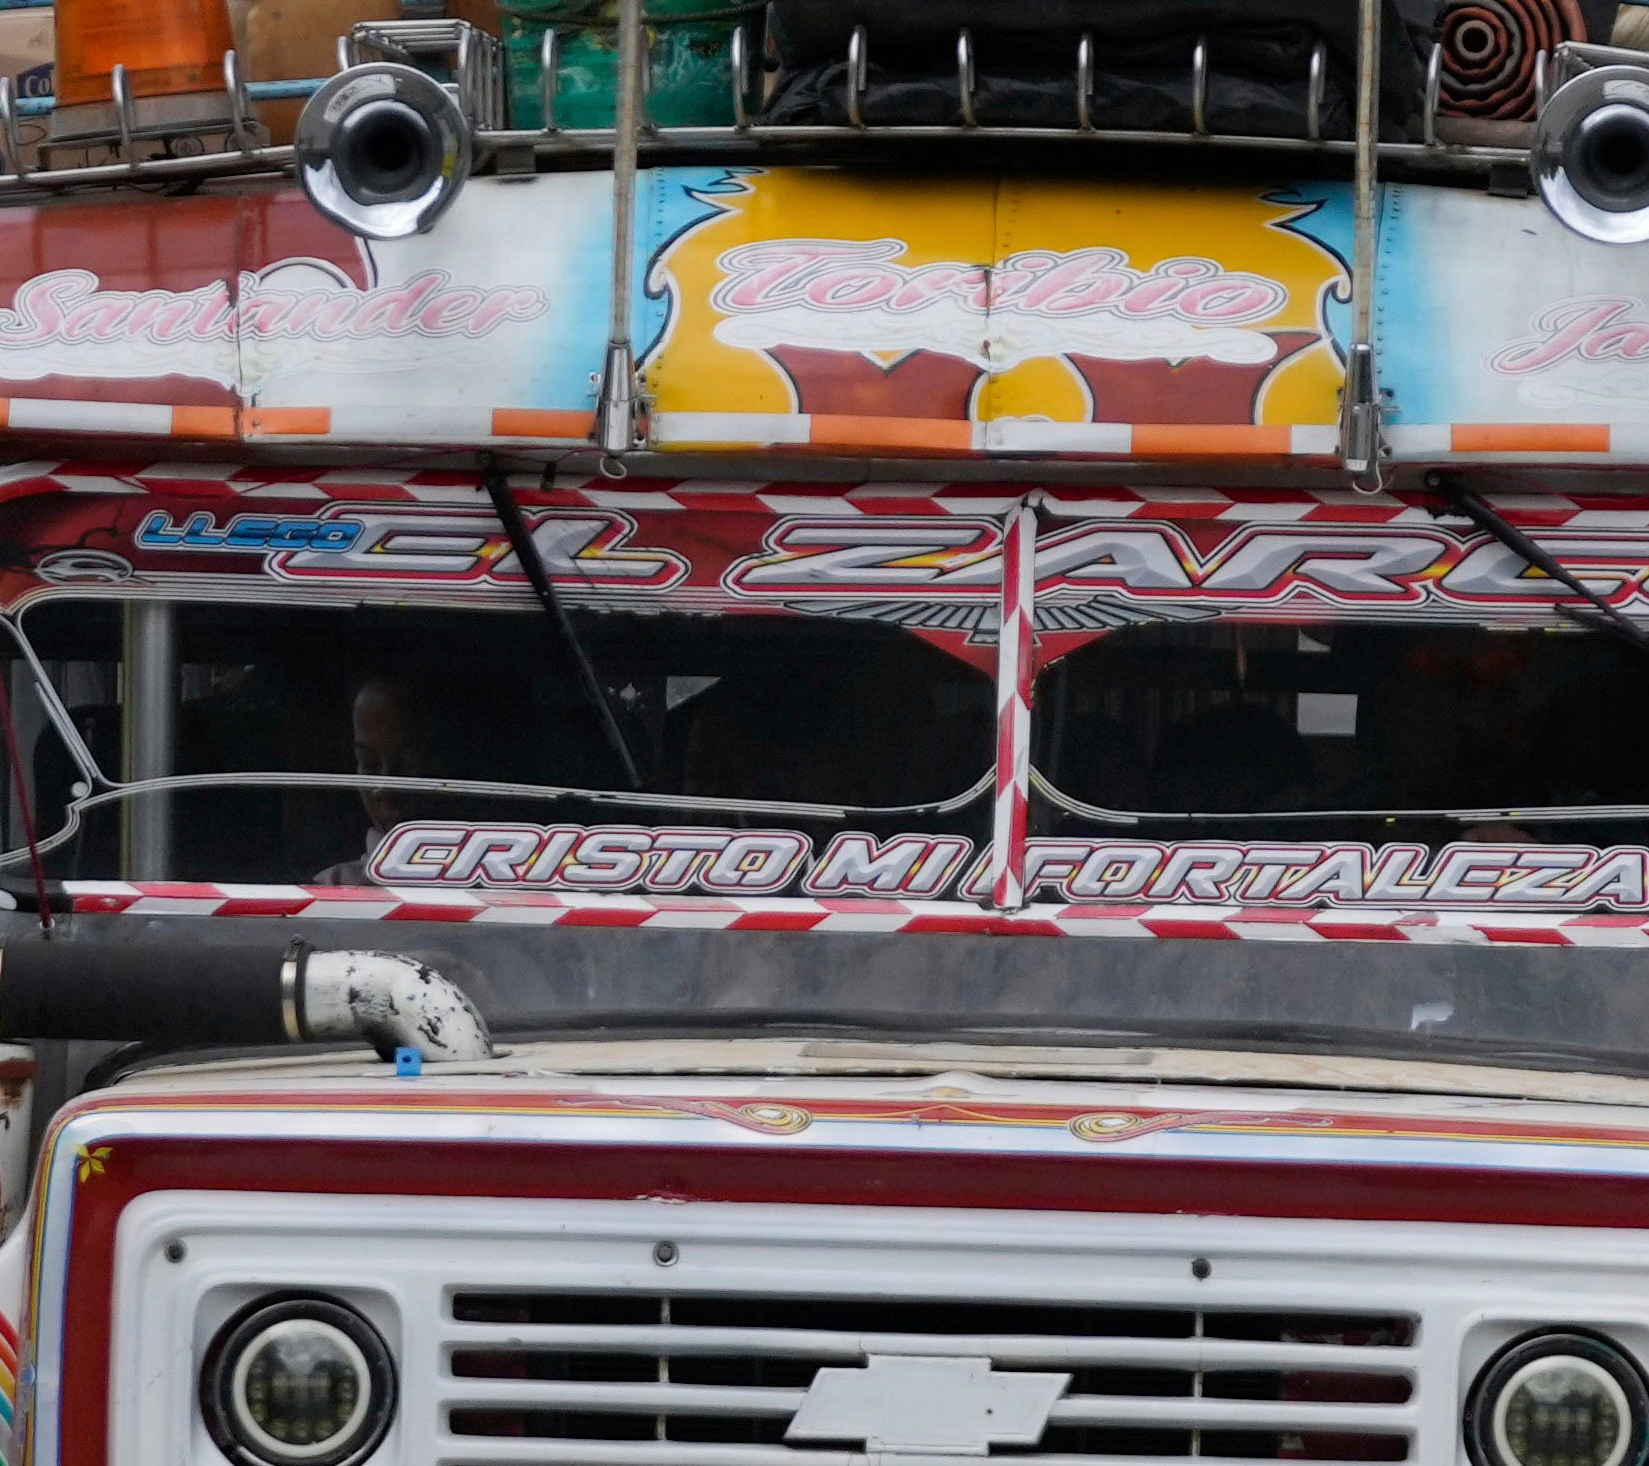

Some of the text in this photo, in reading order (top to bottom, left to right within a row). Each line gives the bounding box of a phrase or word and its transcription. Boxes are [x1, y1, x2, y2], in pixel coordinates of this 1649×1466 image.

[713, 239, 1286, 322] Toribio
[136, 512, 364, 551] LLEGO
[273, 505, 686, 587] EL
[371, 825, 809, 891] CRISTO
[807, 835, 966, 894] MI
